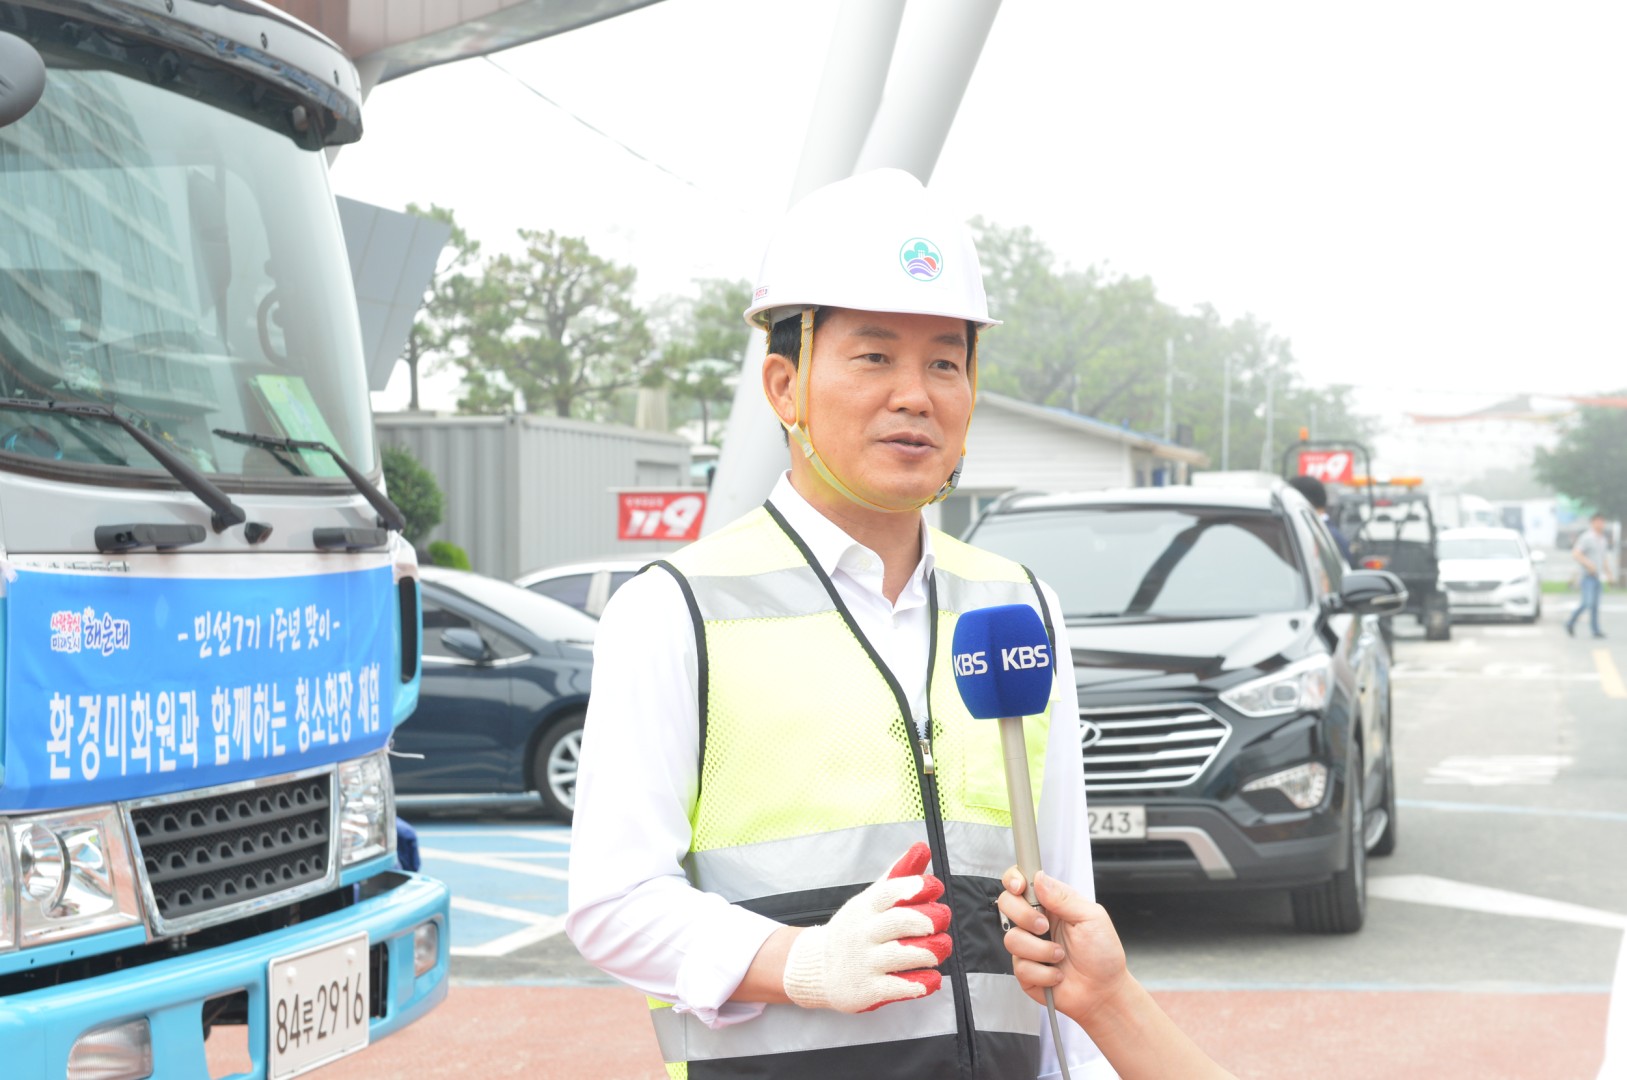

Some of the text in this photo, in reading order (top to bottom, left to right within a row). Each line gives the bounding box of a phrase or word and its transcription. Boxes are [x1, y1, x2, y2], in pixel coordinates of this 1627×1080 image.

[625, 495, 703, 538] 119
[84, 611, 130, 656] 해운대
[268, 607, 301, 653] 1주년
[953, 651, 988, 677] KBS
[1001, 644, 1050, 671] KBS
[46, 662, 380, 781] 환경미화원과 함께하는 청소현장 체험
